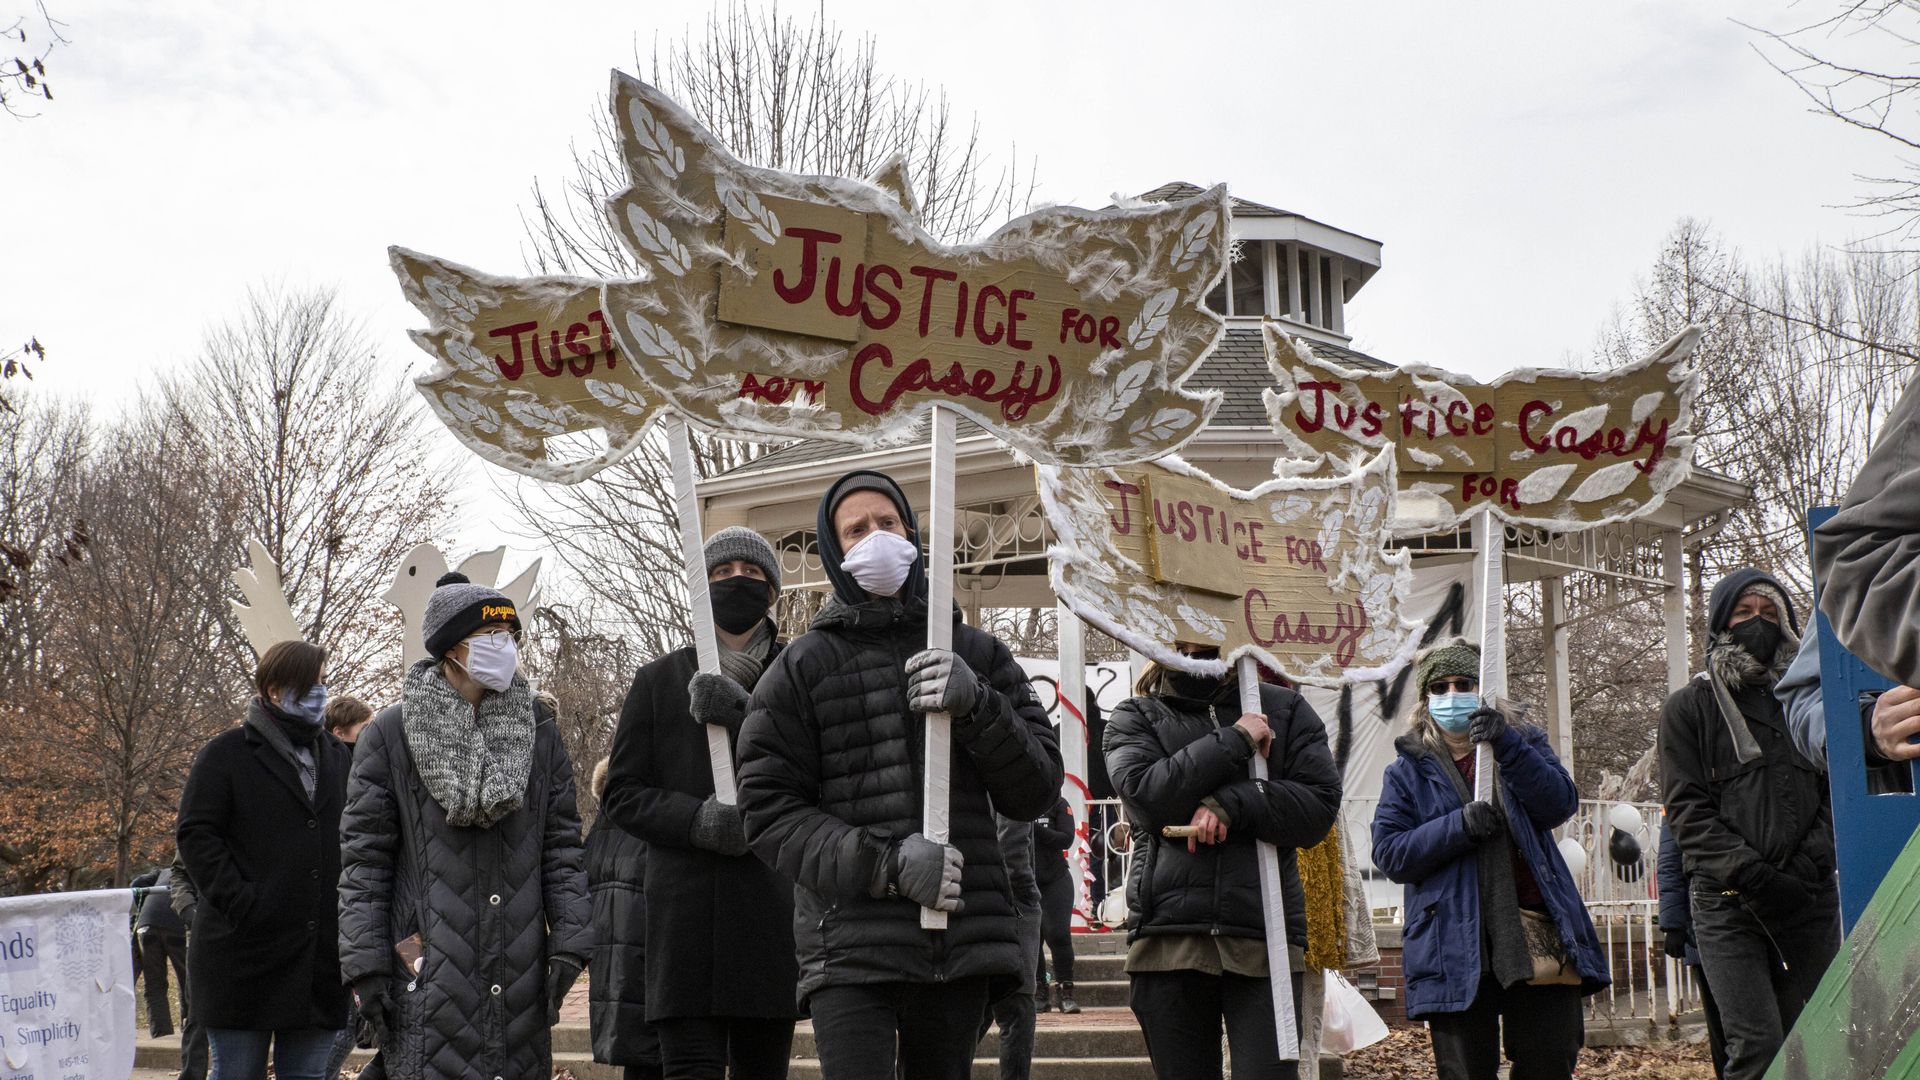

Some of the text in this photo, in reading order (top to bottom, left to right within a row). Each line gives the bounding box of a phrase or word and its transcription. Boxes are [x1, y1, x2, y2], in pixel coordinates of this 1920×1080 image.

[773, 227, 1122, 350] JUSTICE FOR
[489, 310, 616, 381] JUST
[849, 342, 1061, 421] Casey
[1518, 400, 1668, 475] Casey
[1103, 479, 1328, 573] JUSTICE FOR
[1462, 473, 1521, 510] FOR
[1244, 587, 1367, 668] Casey
[0, 932, 34, 961] nds
[2, 991, 57, 1015] Equality
[17, 1021, 81, 1046] Simplicity
